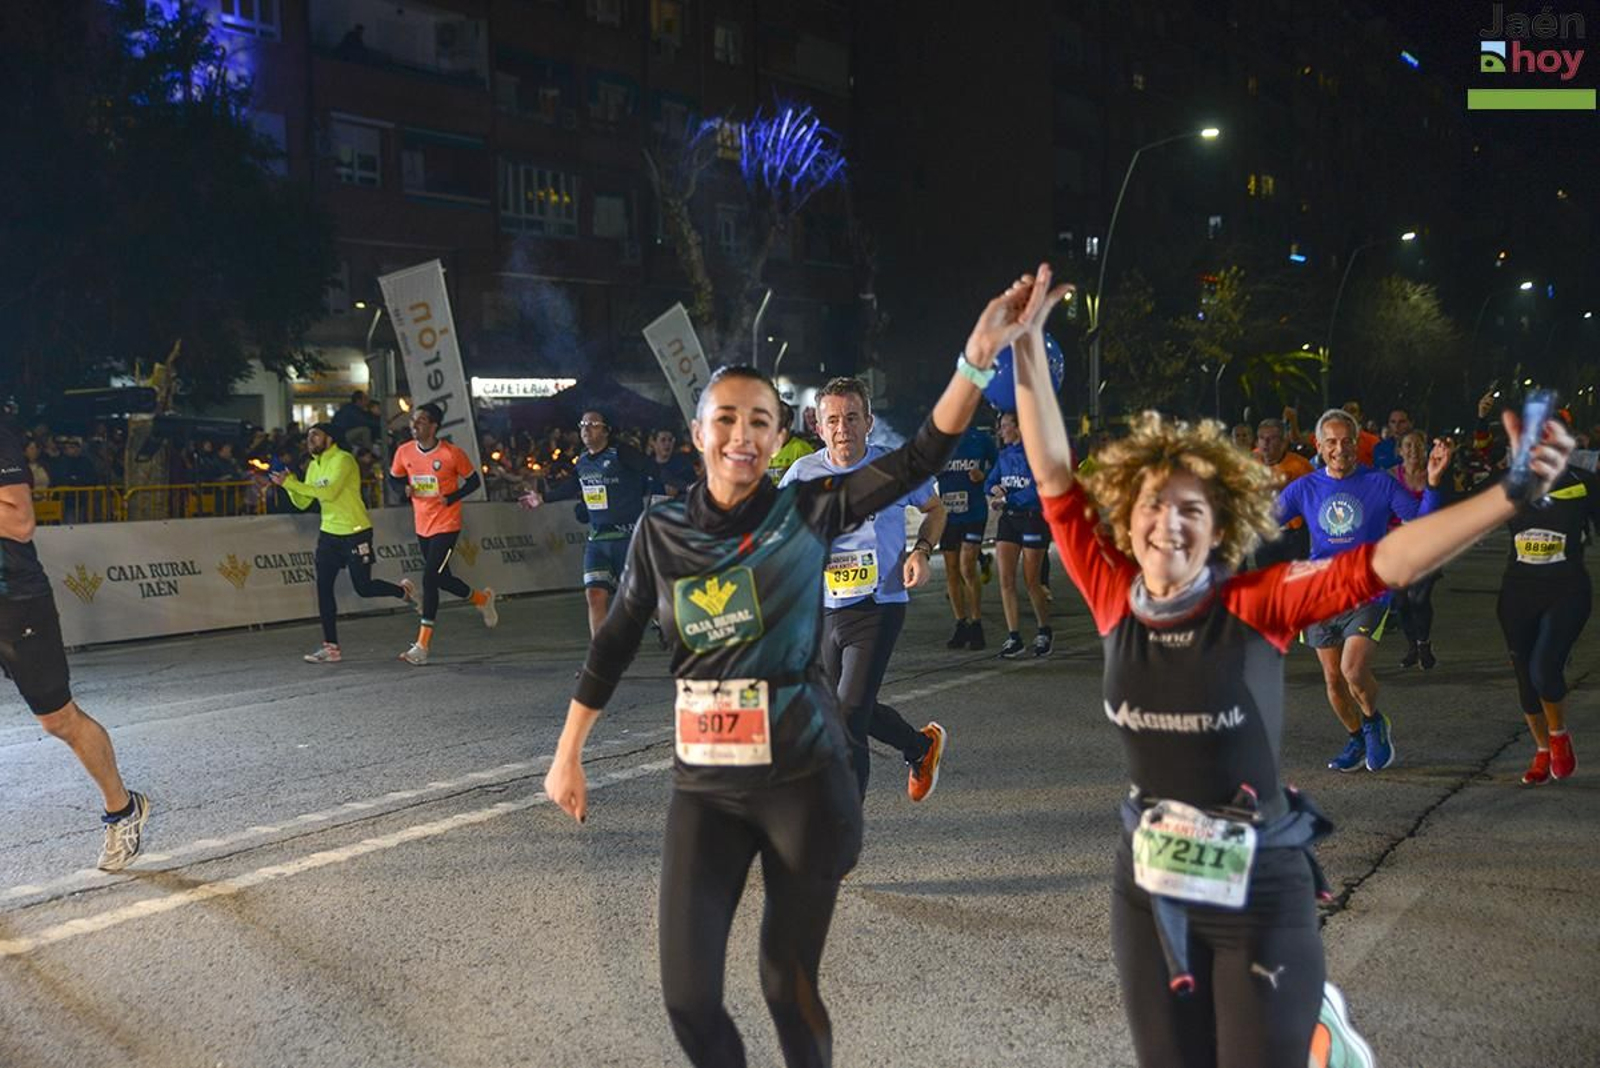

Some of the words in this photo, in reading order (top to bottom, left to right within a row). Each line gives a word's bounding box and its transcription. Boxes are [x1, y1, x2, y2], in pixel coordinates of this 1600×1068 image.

[377, 543, 405, 559] CAJA
[481, 536, 505, 550] CAJA
[254, 552, 288, 570] CAJA
[107, 564, 147, 583] CAJA
[149, 560, 201, 578] RURAL
[698, 713, 740, 734] 607
[1156, 835, 1227, 870] 7211
